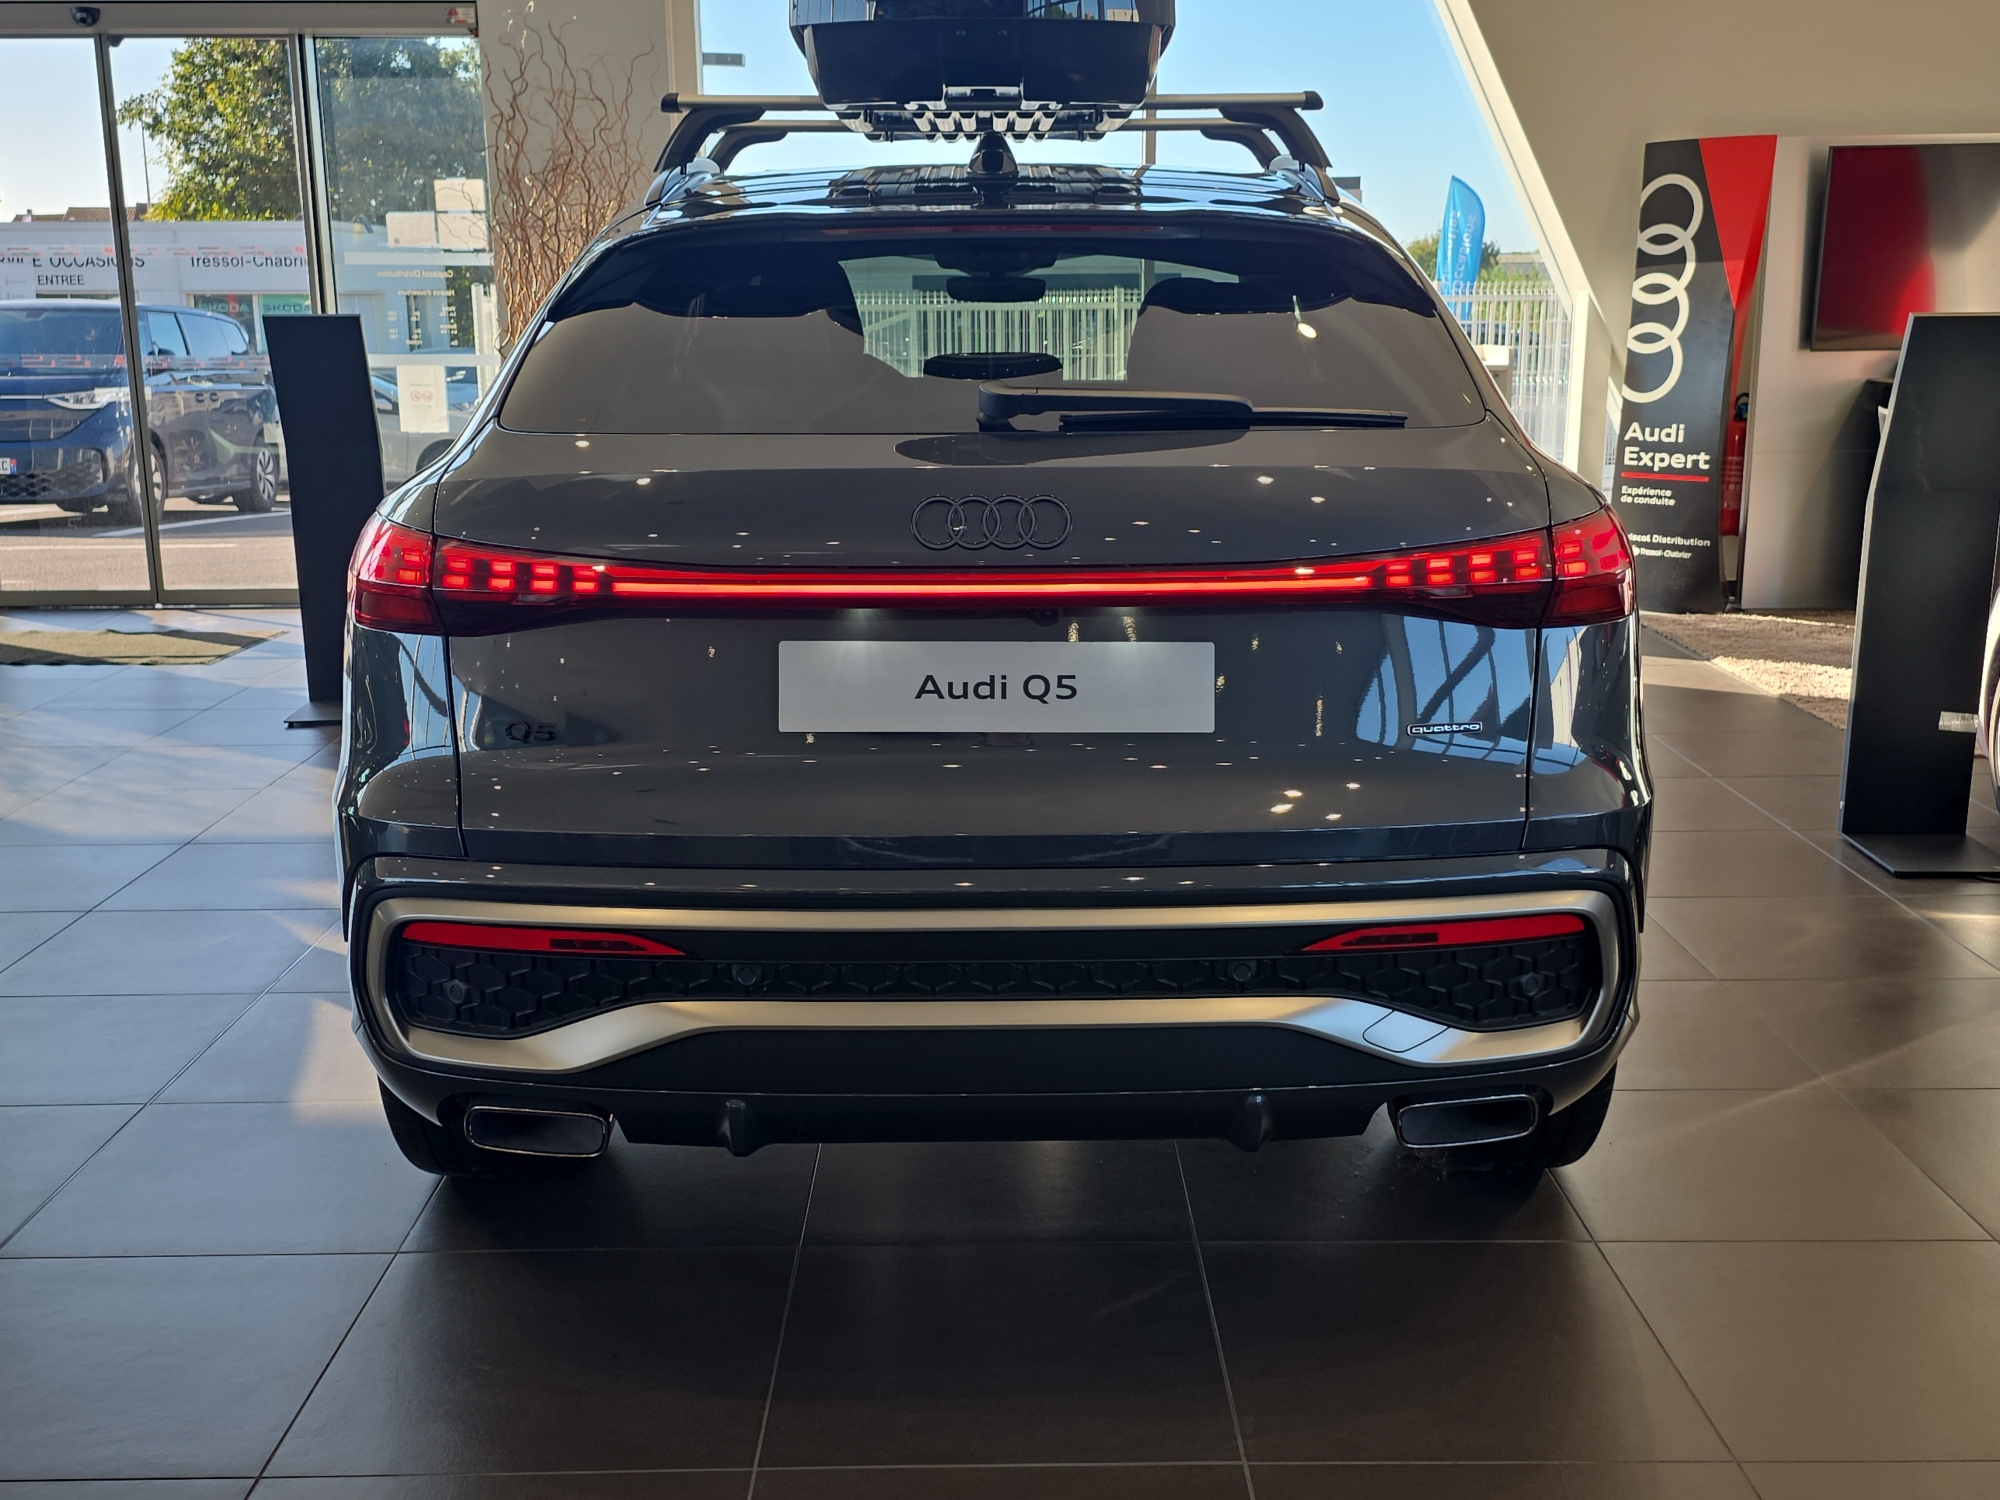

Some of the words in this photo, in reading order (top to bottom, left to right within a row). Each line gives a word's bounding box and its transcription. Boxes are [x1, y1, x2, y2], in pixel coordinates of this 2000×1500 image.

[191, 255, 308, 268] Tressol-Chabri
[37, 274, 85, 286] ENTREE
[1624, 421, 1685, 443] Audi
[1623, 446, 1711, 472] Expert
[1621, 485, 1673, 497] Expérience
[1620, 494, 1633, 503] de
[1633, 496, 1676, 506] conduite
[1652, 534, 1711, 547] Distribution
[914, 674, 1007, 700] Audi
[1022, 674, 1078, 704] Q5
[505, 721, 557, 744] Q5
[1409, 723, 1481, 734] quattro
